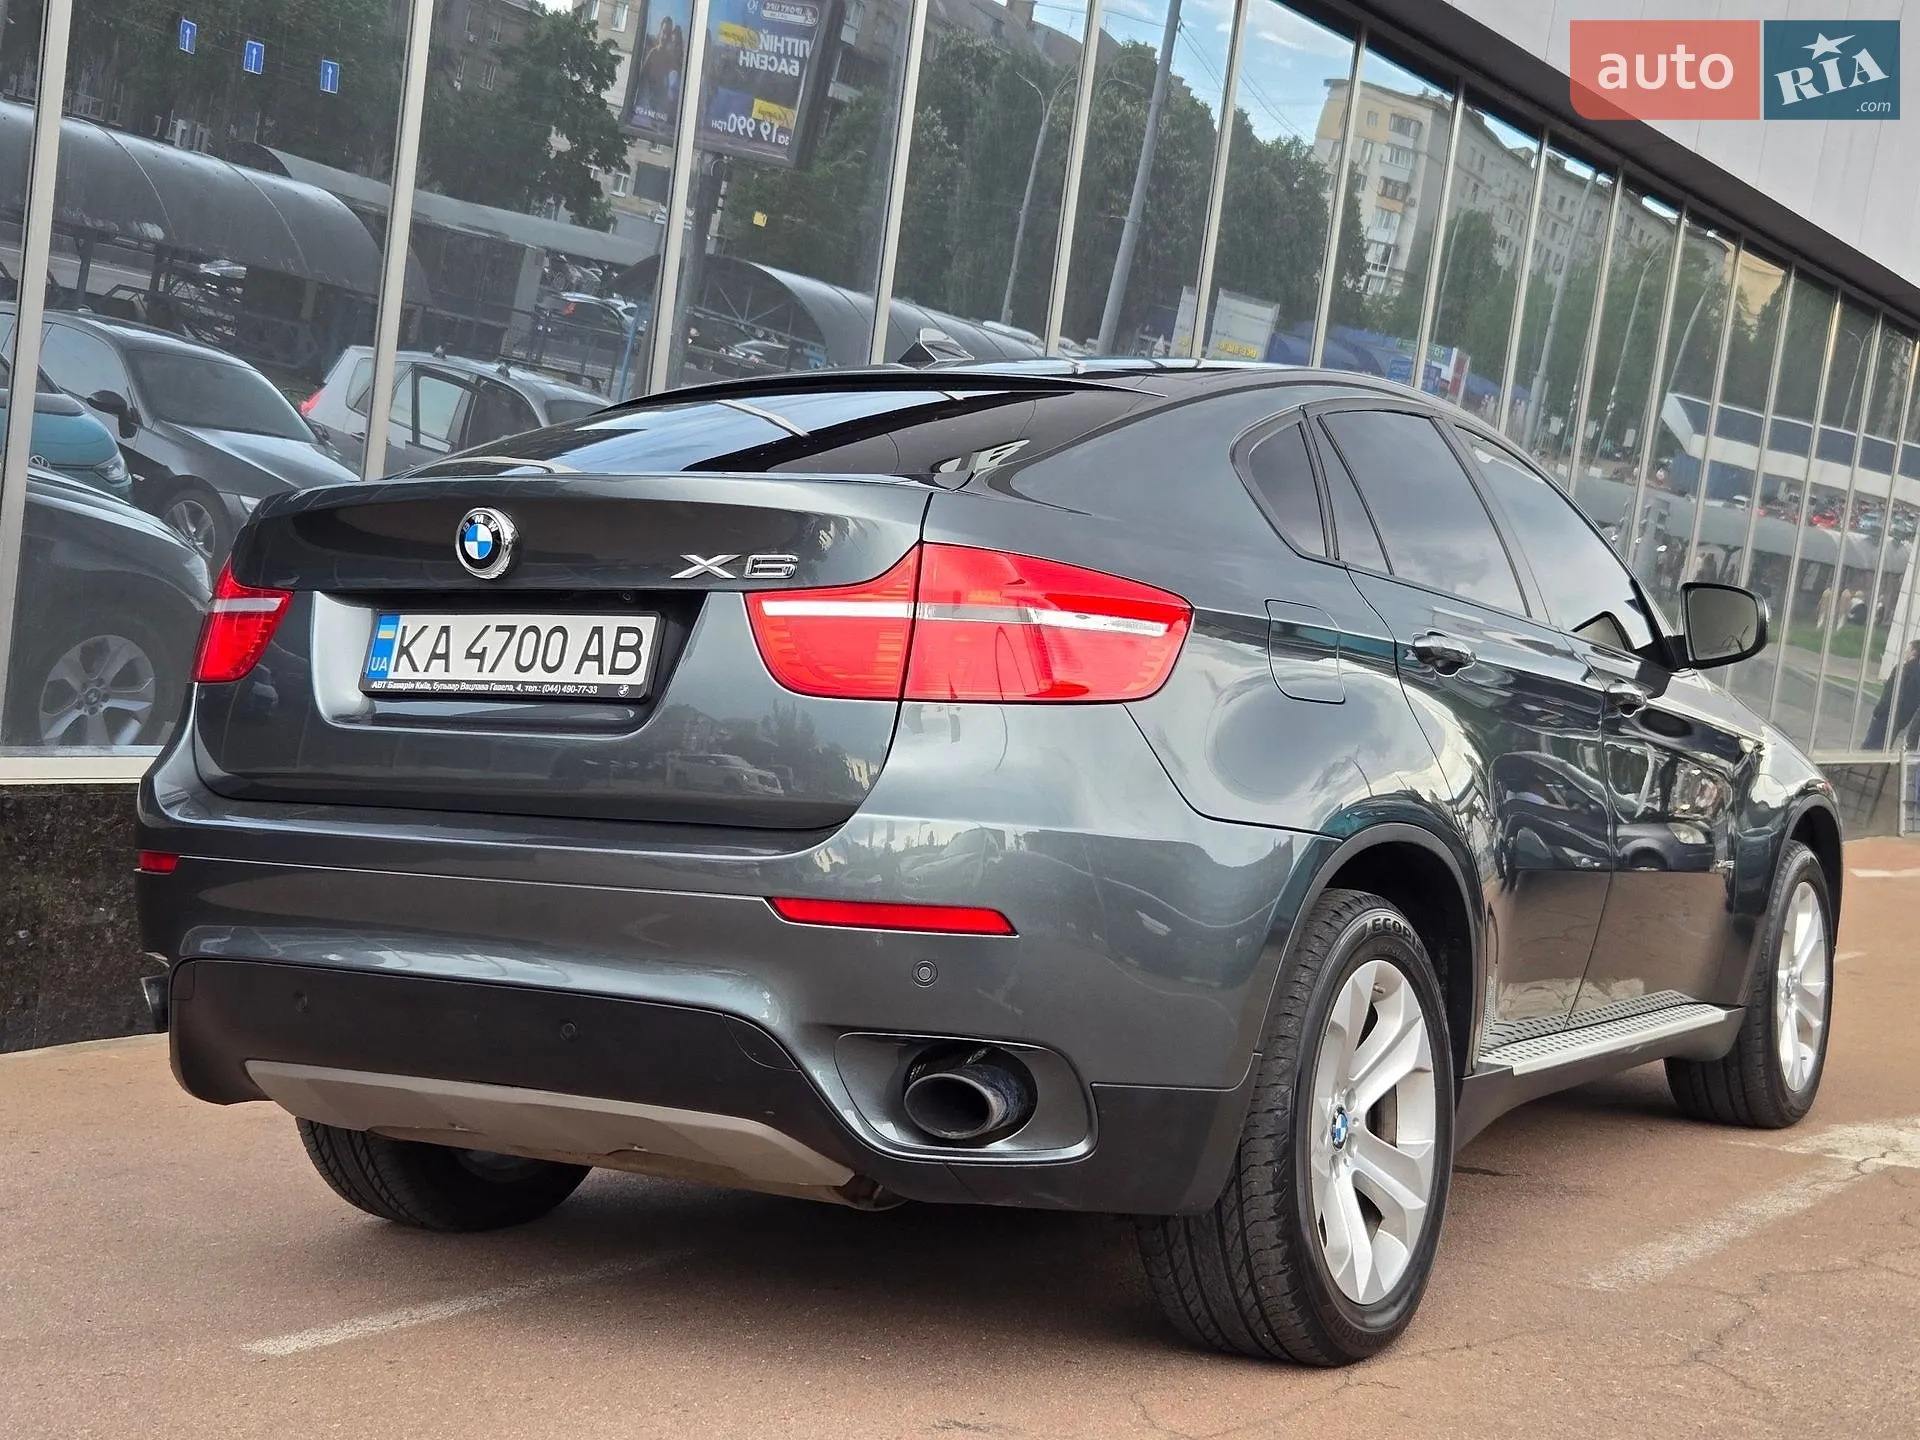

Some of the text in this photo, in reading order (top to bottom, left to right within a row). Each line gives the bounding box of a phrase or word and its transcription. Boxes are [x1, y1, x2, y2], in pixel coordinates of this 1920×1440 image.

[463, 514, 499, 532] BMW
[670, 554, 799, 579] X6
[392, 625, 644, 676] KA 4700 AB
[371, 656, 388, 672] UA
[542, 684, 561, 694] (044)
[562, 684, 598, 694] 490-77-33
